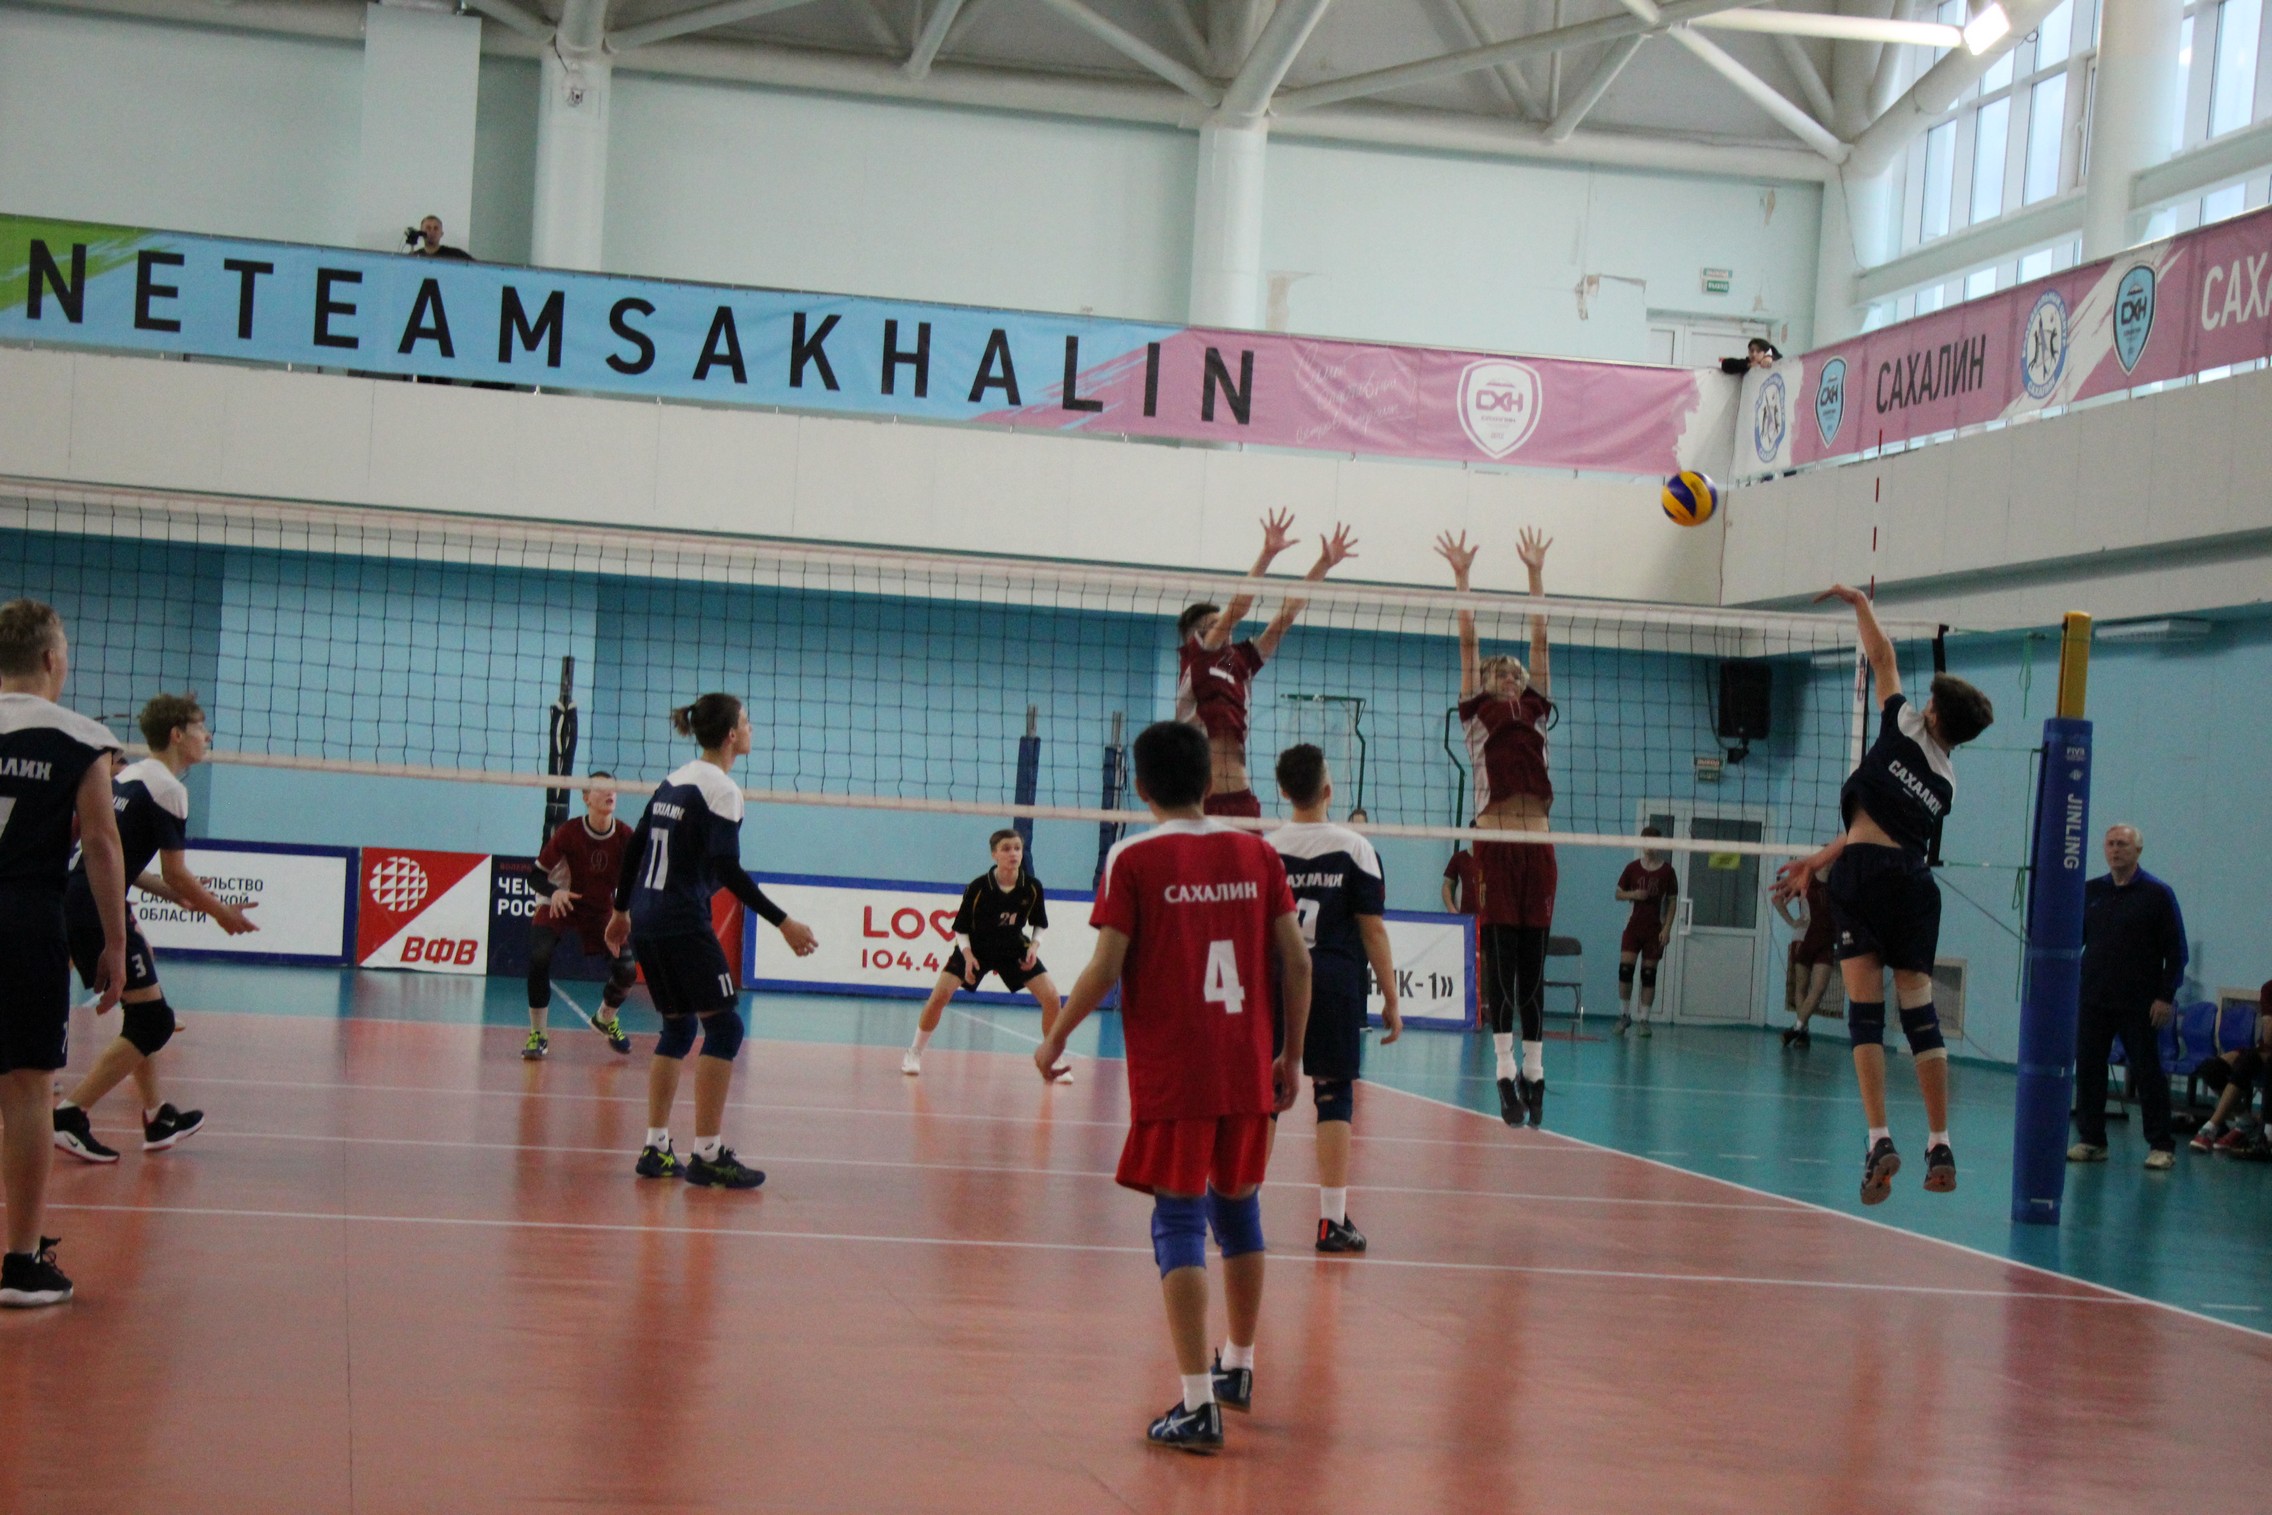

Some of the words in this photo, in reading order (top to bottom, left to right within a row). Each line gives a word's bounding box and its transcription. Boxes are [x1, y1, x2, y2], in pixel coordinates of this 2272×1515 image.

[1876, 333, 1986, 414] САХАЛИН
[2063, 793, 2083, 870] JINLING
[1164, 881, 1259, 903] САХАЛИН
[139, 907, 207, 923] ОБЛАСТИ
[497, 898, 537, 917] РОС
[399, 935, 479, 966] ВФВ
[862, 948, 940, 972] 104.4
[131, 953, 147, 978] 3
[1203, 939, 1246, 1015] 4
